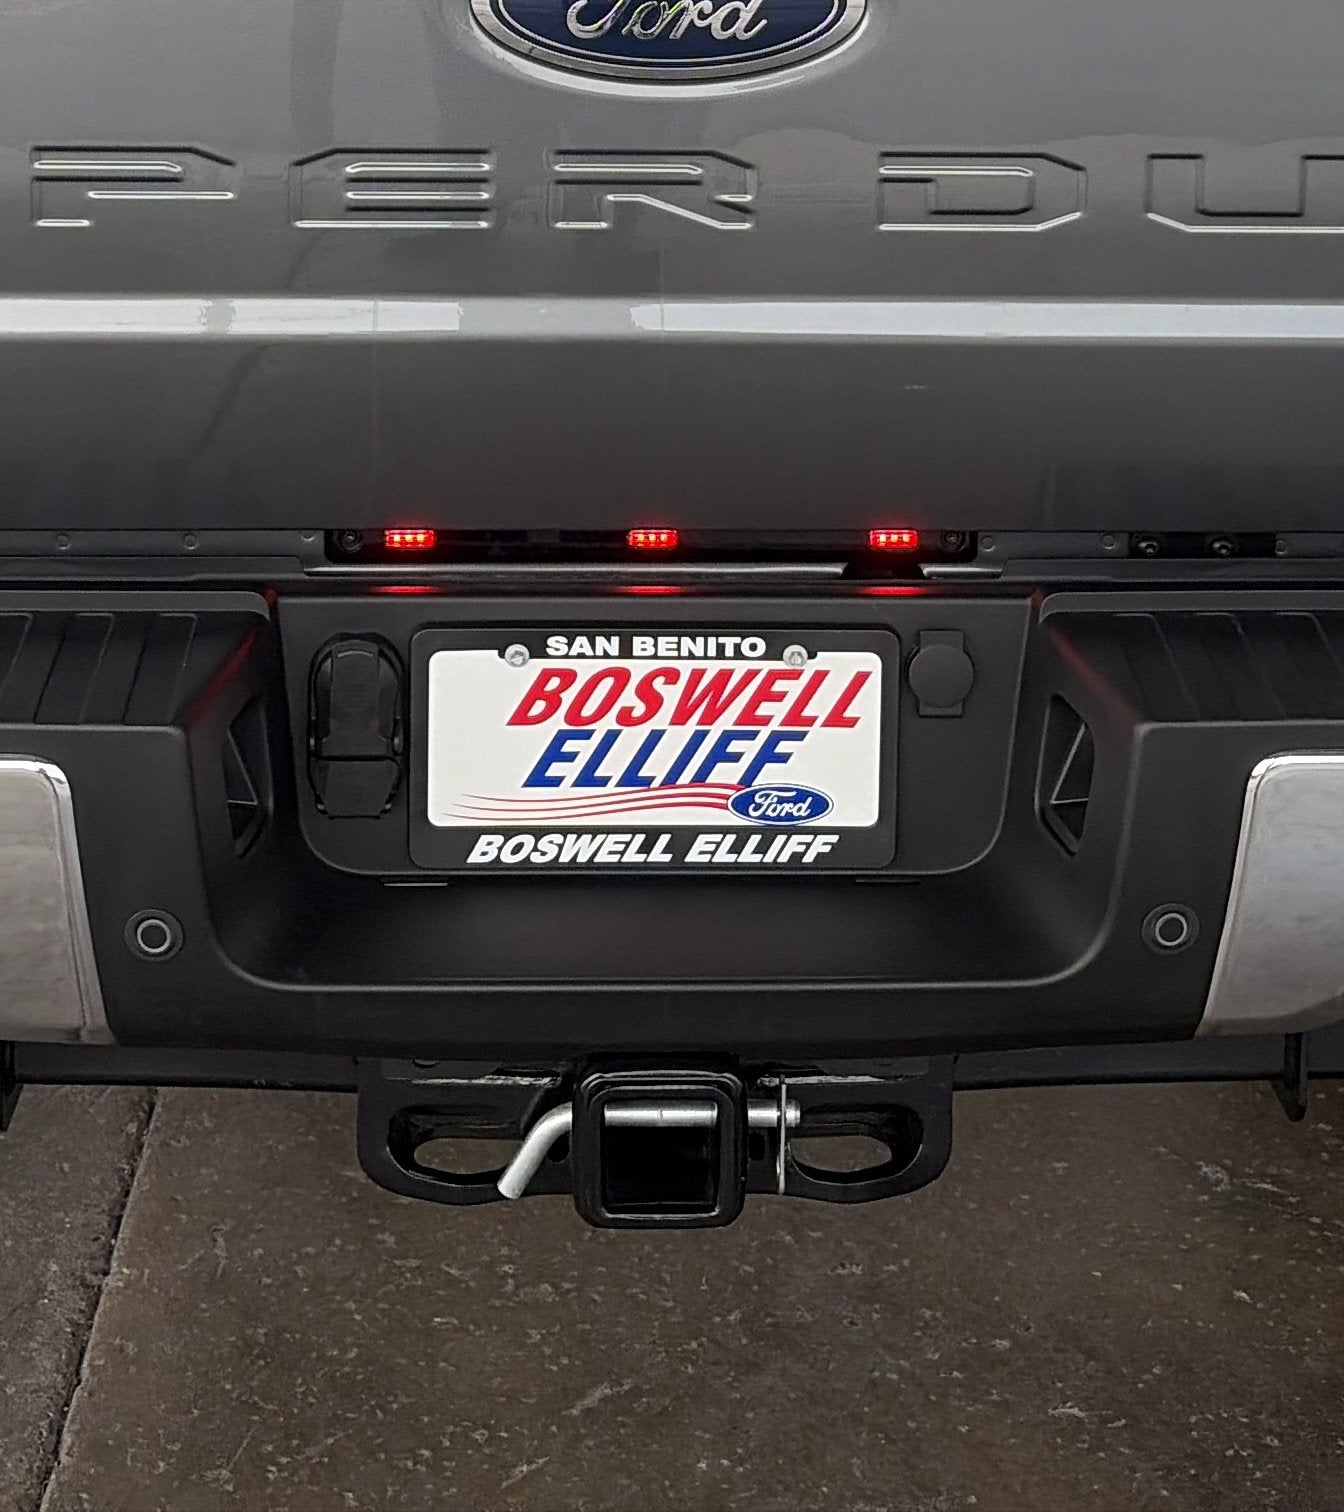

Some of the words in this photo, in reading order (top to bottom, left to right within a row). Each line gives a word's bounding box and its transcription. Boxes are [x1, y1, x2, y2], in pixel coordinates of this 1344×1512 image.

[546, 635, 620, 658] SAN
[632, 635, 767, 658] BENITO
[505, 667, 872, 728] BOSWELL
[521, 729, 810, 788] ELLIFF
[748, 790, 813, 818] Ford
[466, 834, 676, 864] BOSWELL
[684, 834, 839, 864] ELLIFF
